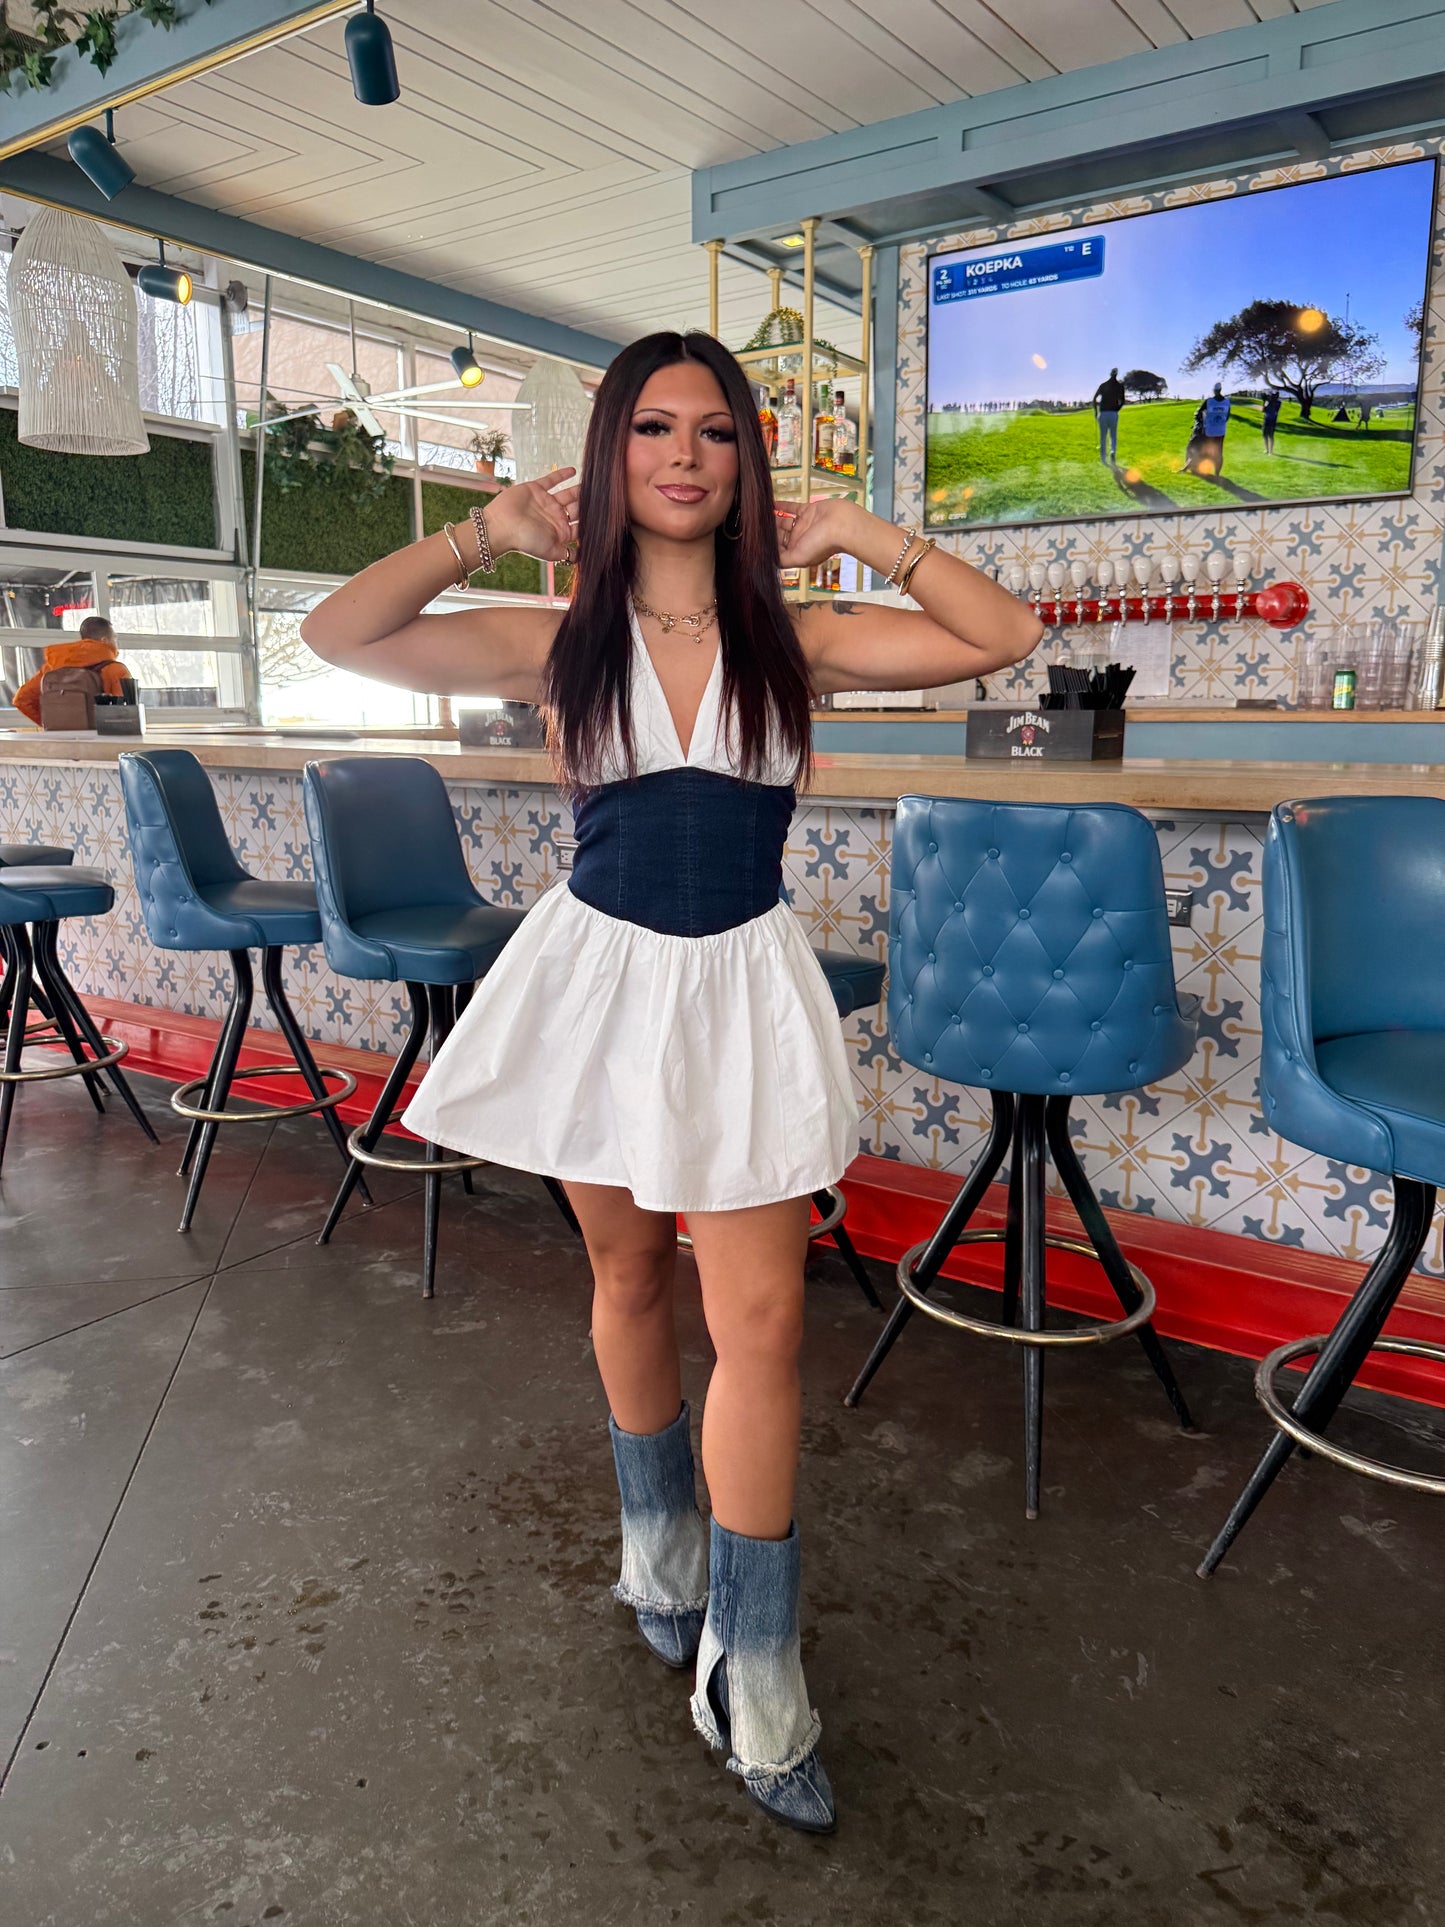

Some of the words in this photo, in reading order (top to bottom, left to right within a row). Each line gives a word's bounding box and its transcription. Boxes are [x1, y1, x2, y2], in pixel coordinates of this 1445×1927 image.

[1082, 242, 1092, 256] E
[966, 256, 1023, 277] KOEPKA
[940, 269, 948, 280] 2
[978, 284, 998, 294] YARDS
[1037, 273, 1059, 283] YARDS
[1006, 715, 1025, 734] JIM
[1024, 711, 1050, 734] BEAM
[489, 736, 512, 746] BLACK
[1011, 746, 1044, 757] BLACK
